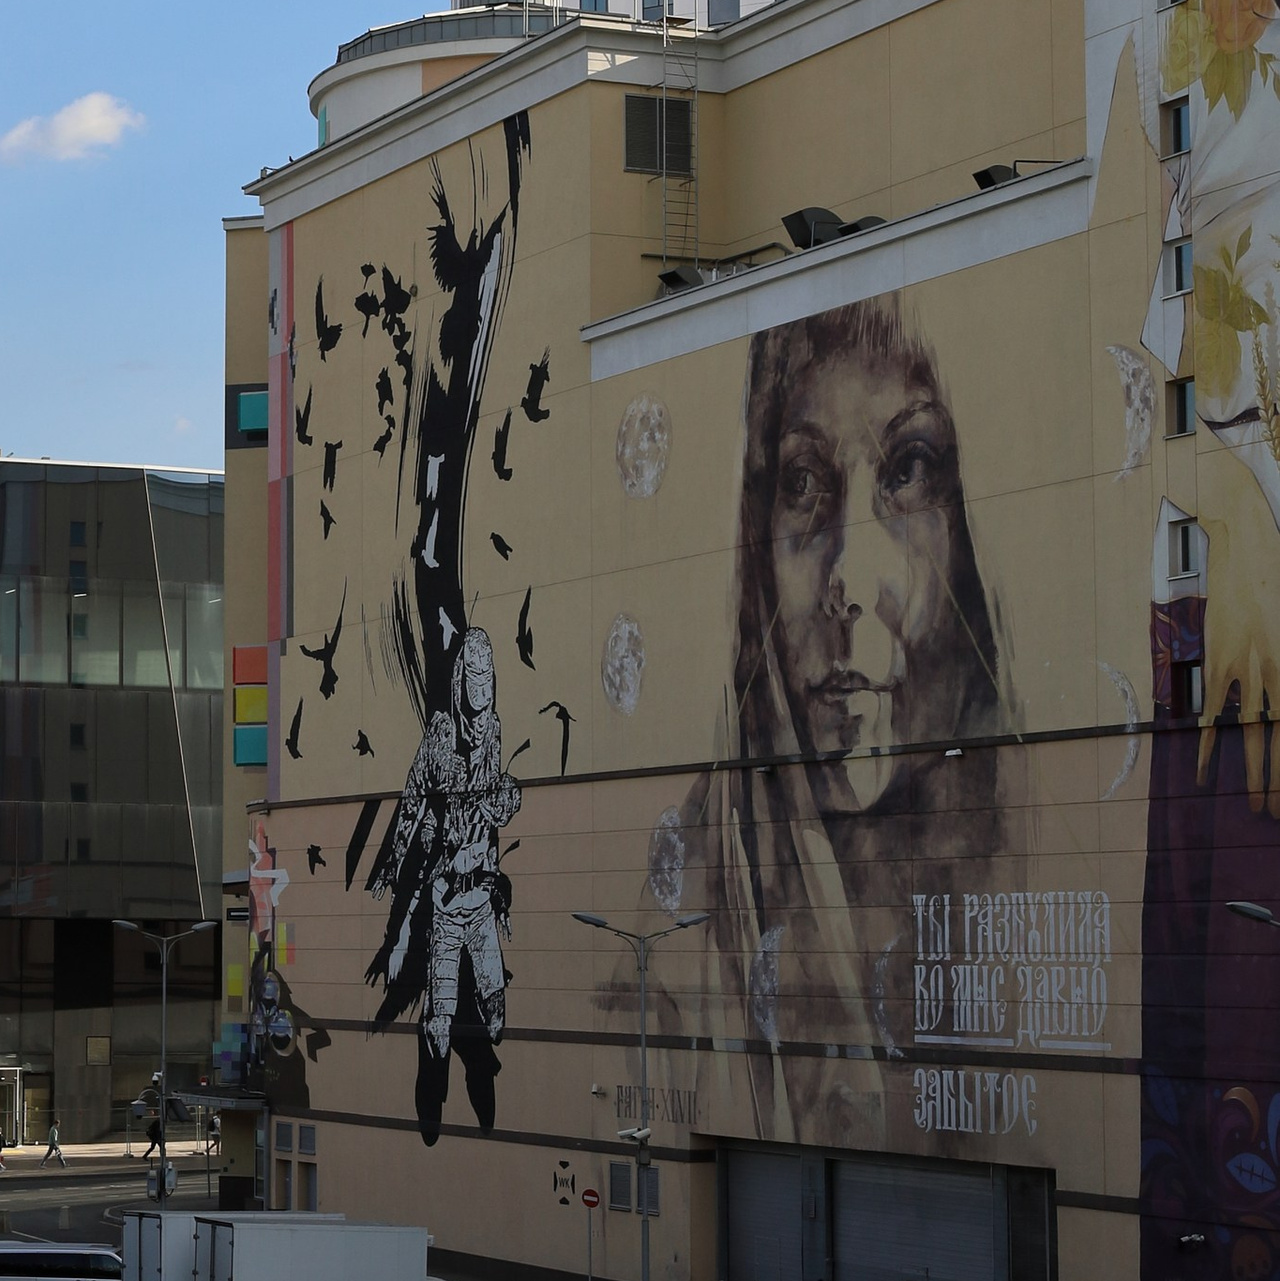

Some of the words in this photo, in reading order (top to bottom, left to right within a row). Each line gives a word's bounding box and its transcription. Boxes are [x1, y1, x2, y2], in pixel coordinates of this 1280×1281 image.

[912, 893, 951, 961] ТЫ
[914, 964, 944, 1031] ВО
[951, 964, 1008, 1033] МНЕ
[1016, 966, 1108, 1049] ДАВНО
[913, 1068, 1038, 1136] ЗАБЫТОЕ
